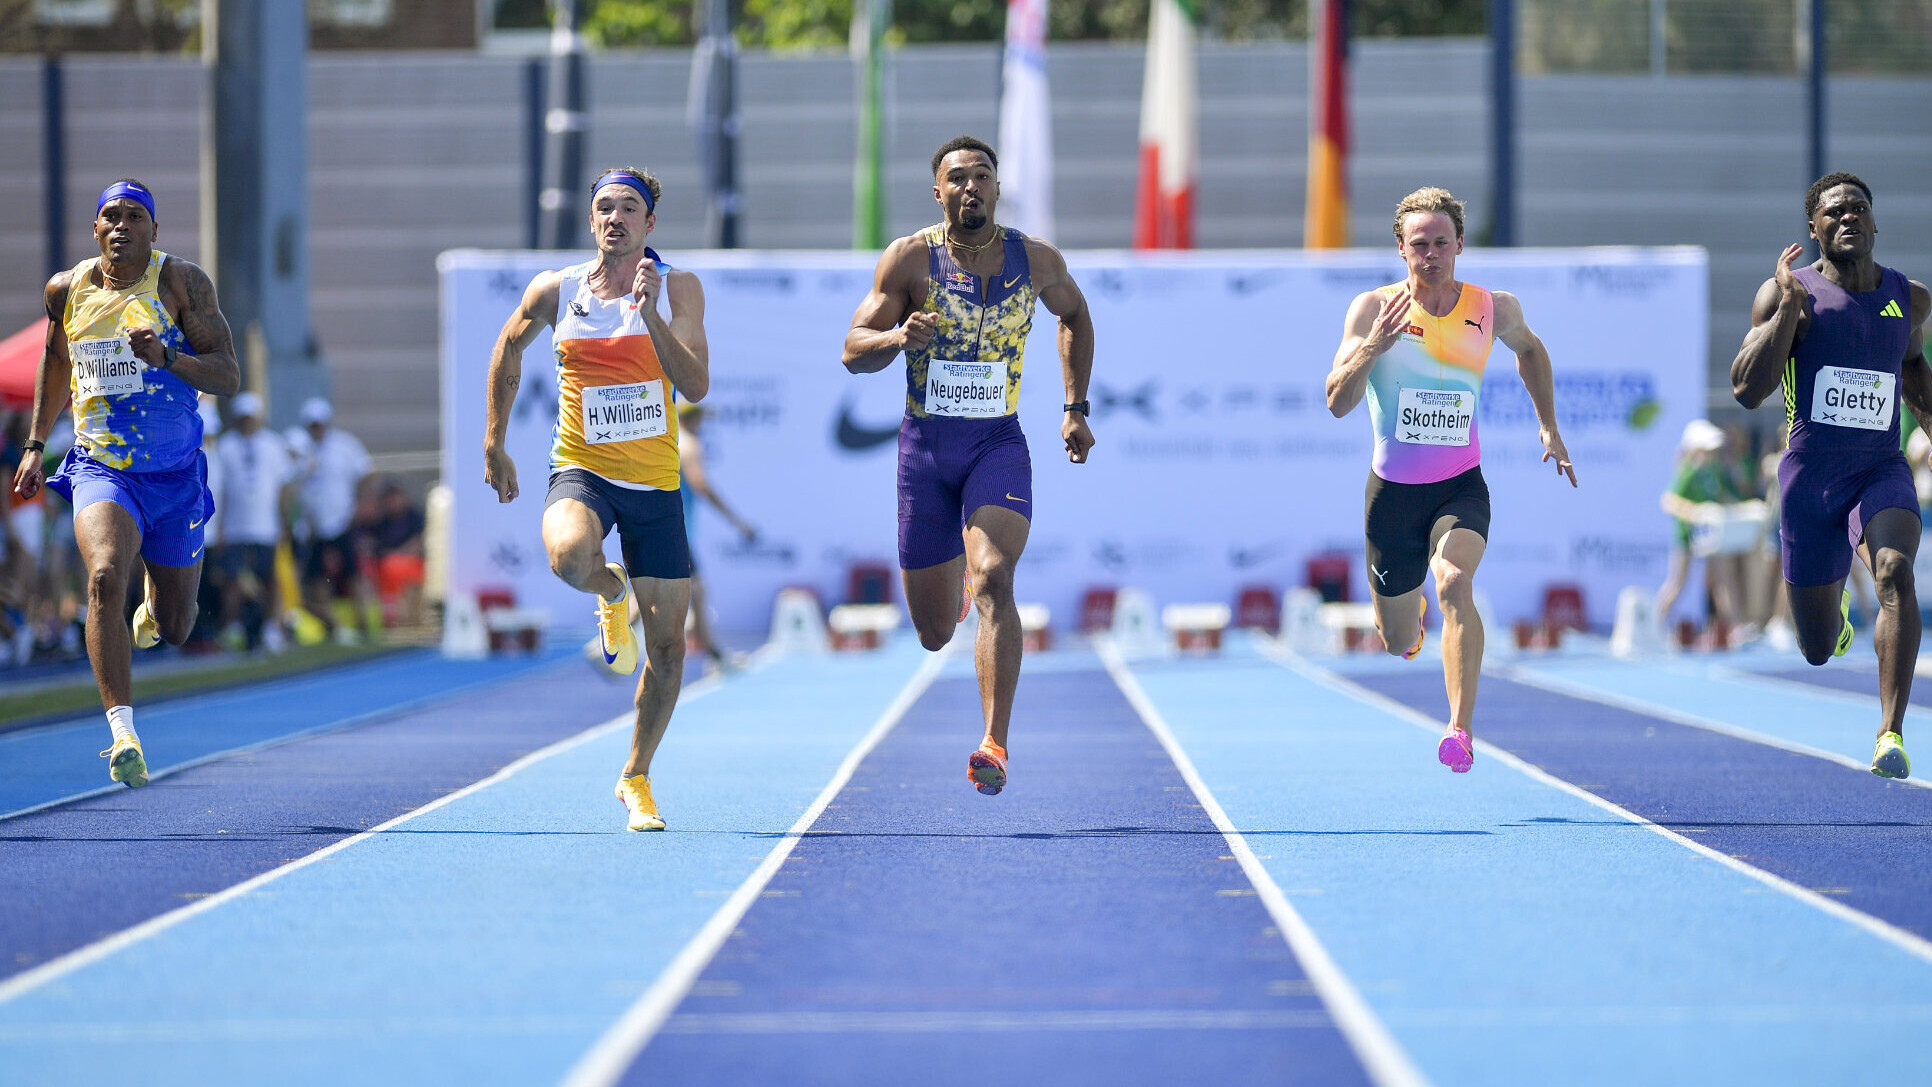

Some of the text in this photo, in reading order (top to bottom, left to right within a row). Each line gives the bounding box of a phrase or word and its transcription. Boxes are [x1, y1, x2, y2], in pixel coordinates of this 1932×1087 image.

[85, 347, 115, 356] Ratingen
[77, 358, 137, 379] D.Williams
[950, 370, 985, 379] Ratingen
[1840, 377, 1874, 387] Ratingen
[93, 383, 133, 392] XPENG
[930, 378, 1004, 404] Neugebauer
[605, 393, 641, 402] Ratingen
[1416, 391, 1461, 401] Stadtwerke
[1422, 398, 1455, 407] Ratingen
[1825, 387, 1887, 416] Gletty
[588, 403, 662, 426] H.Williams
[1402, 408, 1470, 429] Skotheim
[1840, 416, 1884, 426] XPENG
[614, 426, 657, 437] XPENG
